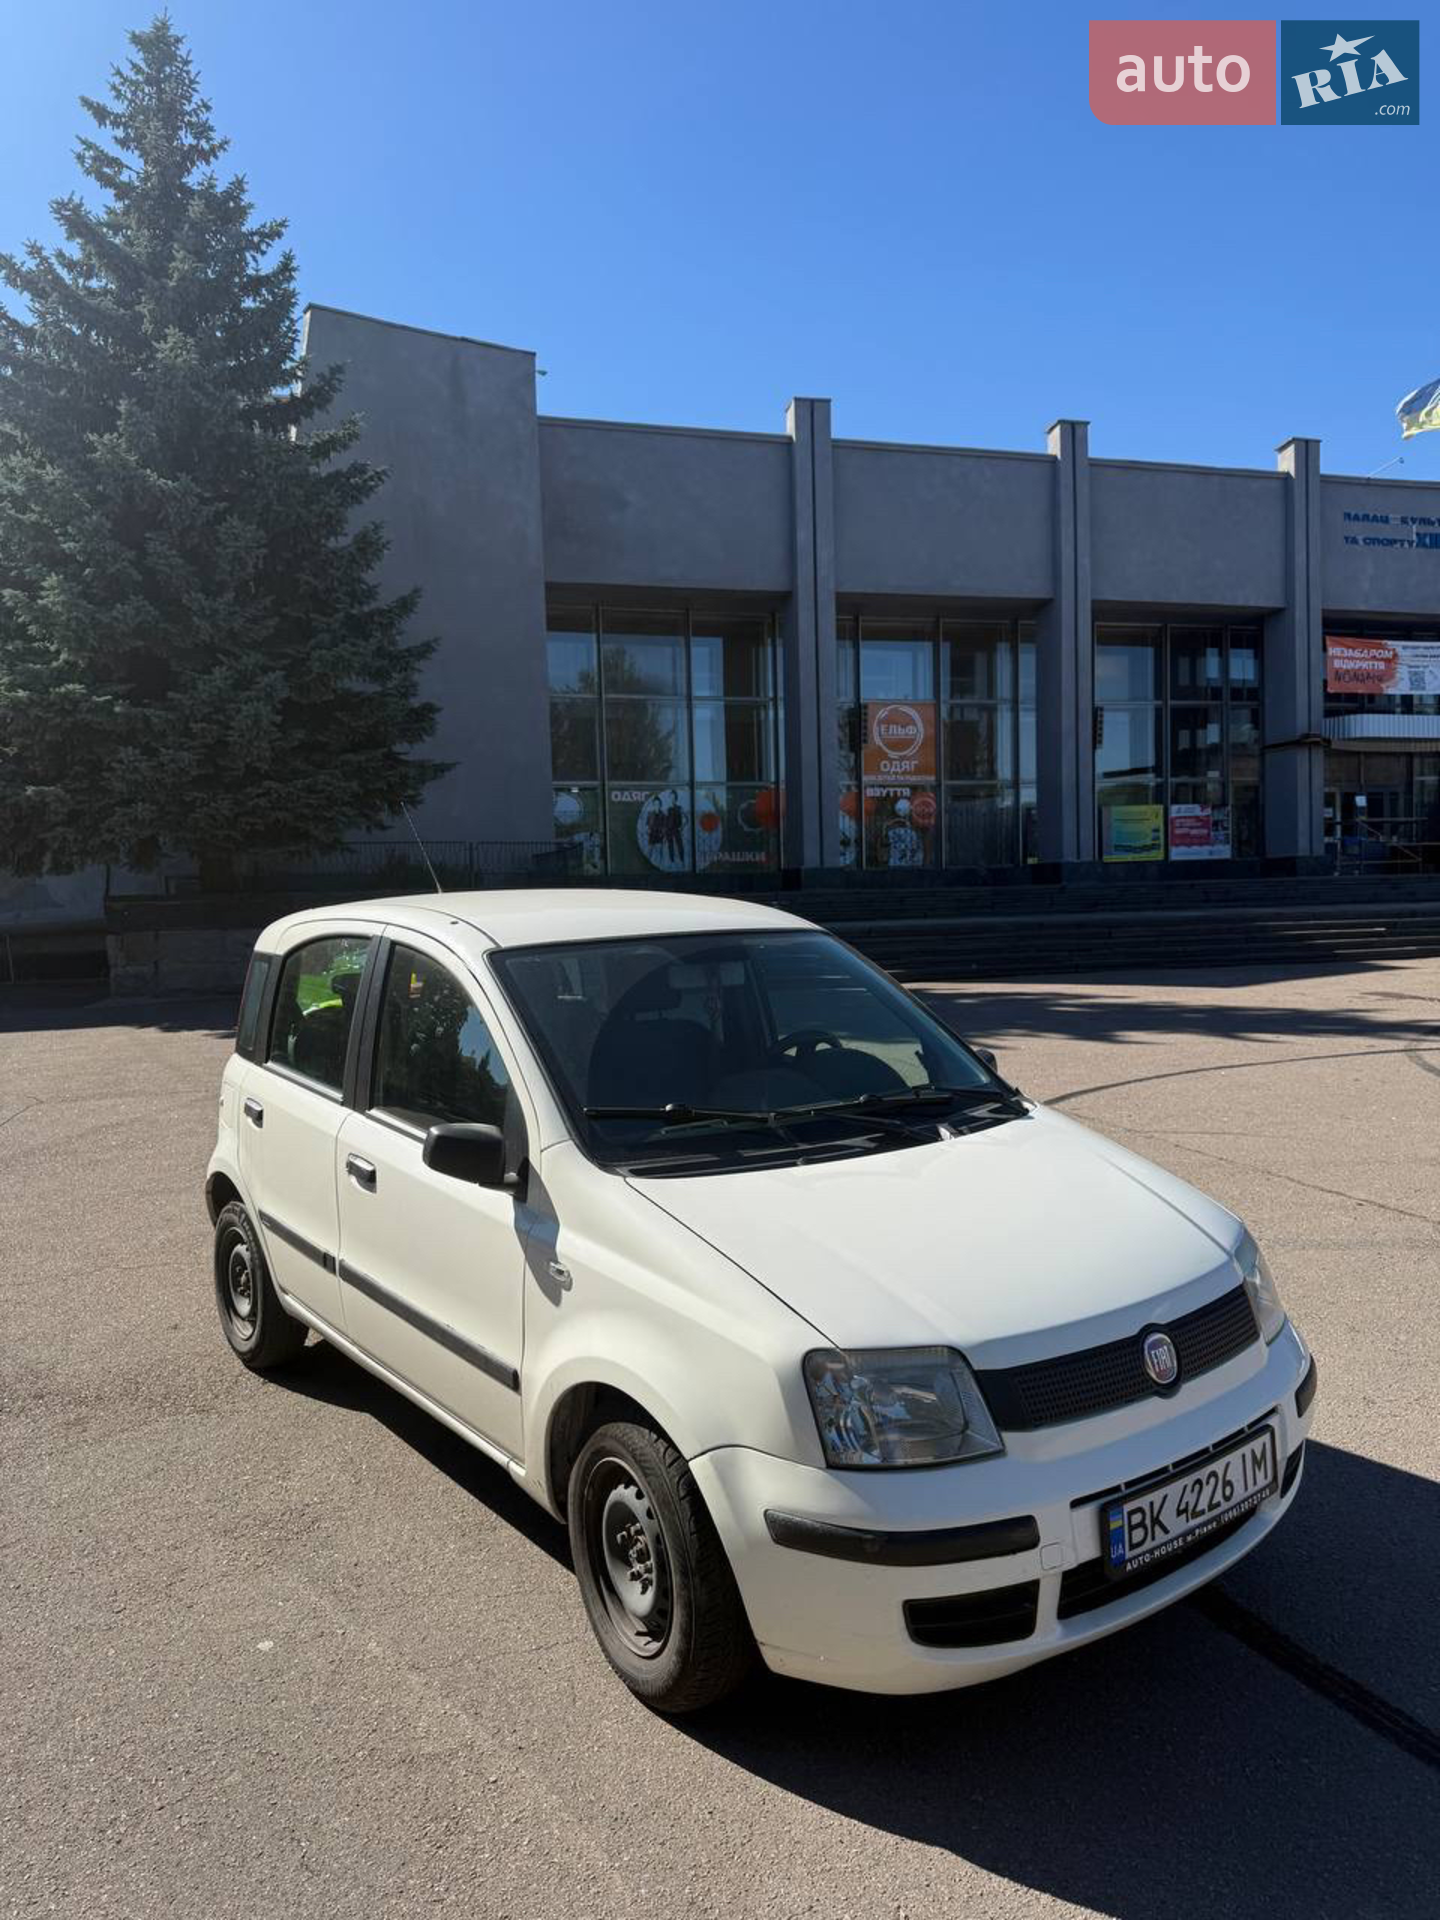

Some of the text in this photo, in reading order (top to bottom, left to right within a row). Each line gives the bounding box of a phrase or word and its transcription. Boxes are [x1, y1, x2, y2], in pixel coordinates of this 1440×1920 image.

[880, 723, 917, 736] ЕЛЬФ
[879, 760, 919, 774] ОДЯГ
[1127, 1442, 1268, 1552] BK 4226 IM
[1110, 1543, 1125, 1559] UA
[1126, 1536, 1184, 1572] AUTO-HOUSE
